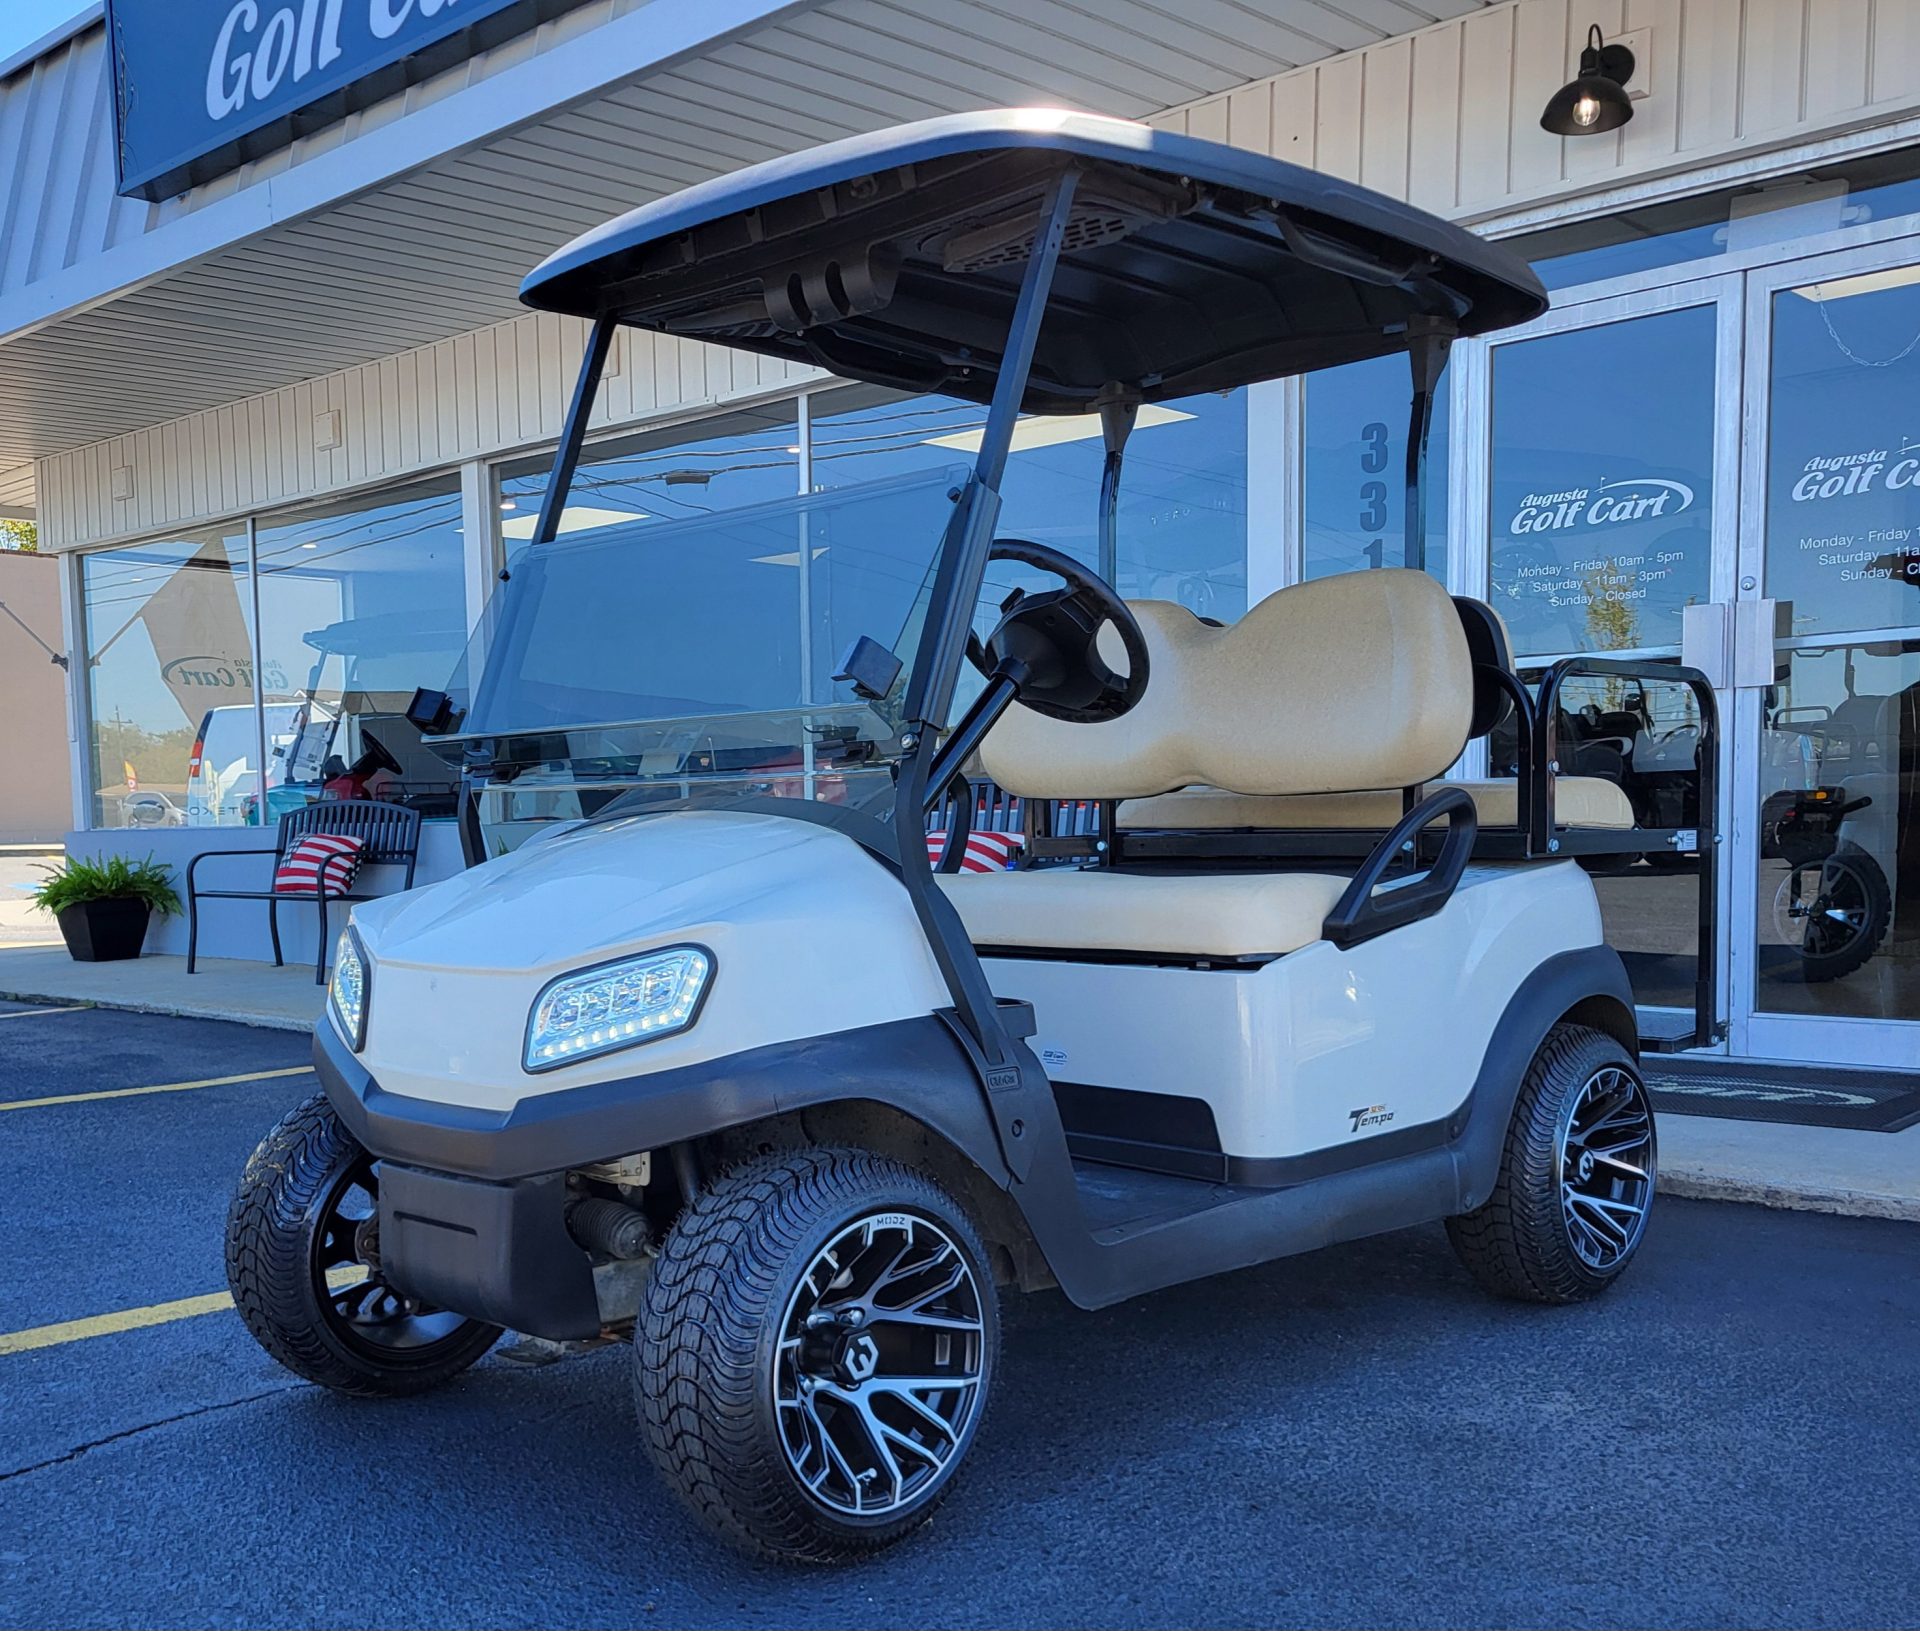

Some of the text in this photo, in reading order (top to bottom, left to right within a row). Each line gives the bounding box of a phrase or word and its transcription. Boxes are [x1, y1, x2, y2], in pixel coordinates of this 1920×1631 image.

[1803, 449, 1888, 472] Augusta
[1792, 464, 1883, 501] Golf
[1520, 488, 1589, 508] Augusta
[1510, 489, 1670, 535] Golf Cart
[1800, 535, 1854, 550] Monday
[1868, 529, 1911, 542] Friday
[1517, 564, 1562, 578] Monday
[1573, 559, 1608, 573] Friday
[1613, 556, 1644, 567] 10am
[1656, 551, 1684, 565] 5pm
[1819, 550, 1880, 566] Saturday
[1533, 578, 1583, 593] Saturday
[1595, 574, 1627, 586] 11am
[1639, 569, 1665, 583] 3pm
[1841, 567, 1893, 581] Sunday
[1551, 593, 1594, 607] Sunday
[1605, 588, 1646, 601] Closed
[1349, 1107, 1394, 1133] Tempo
